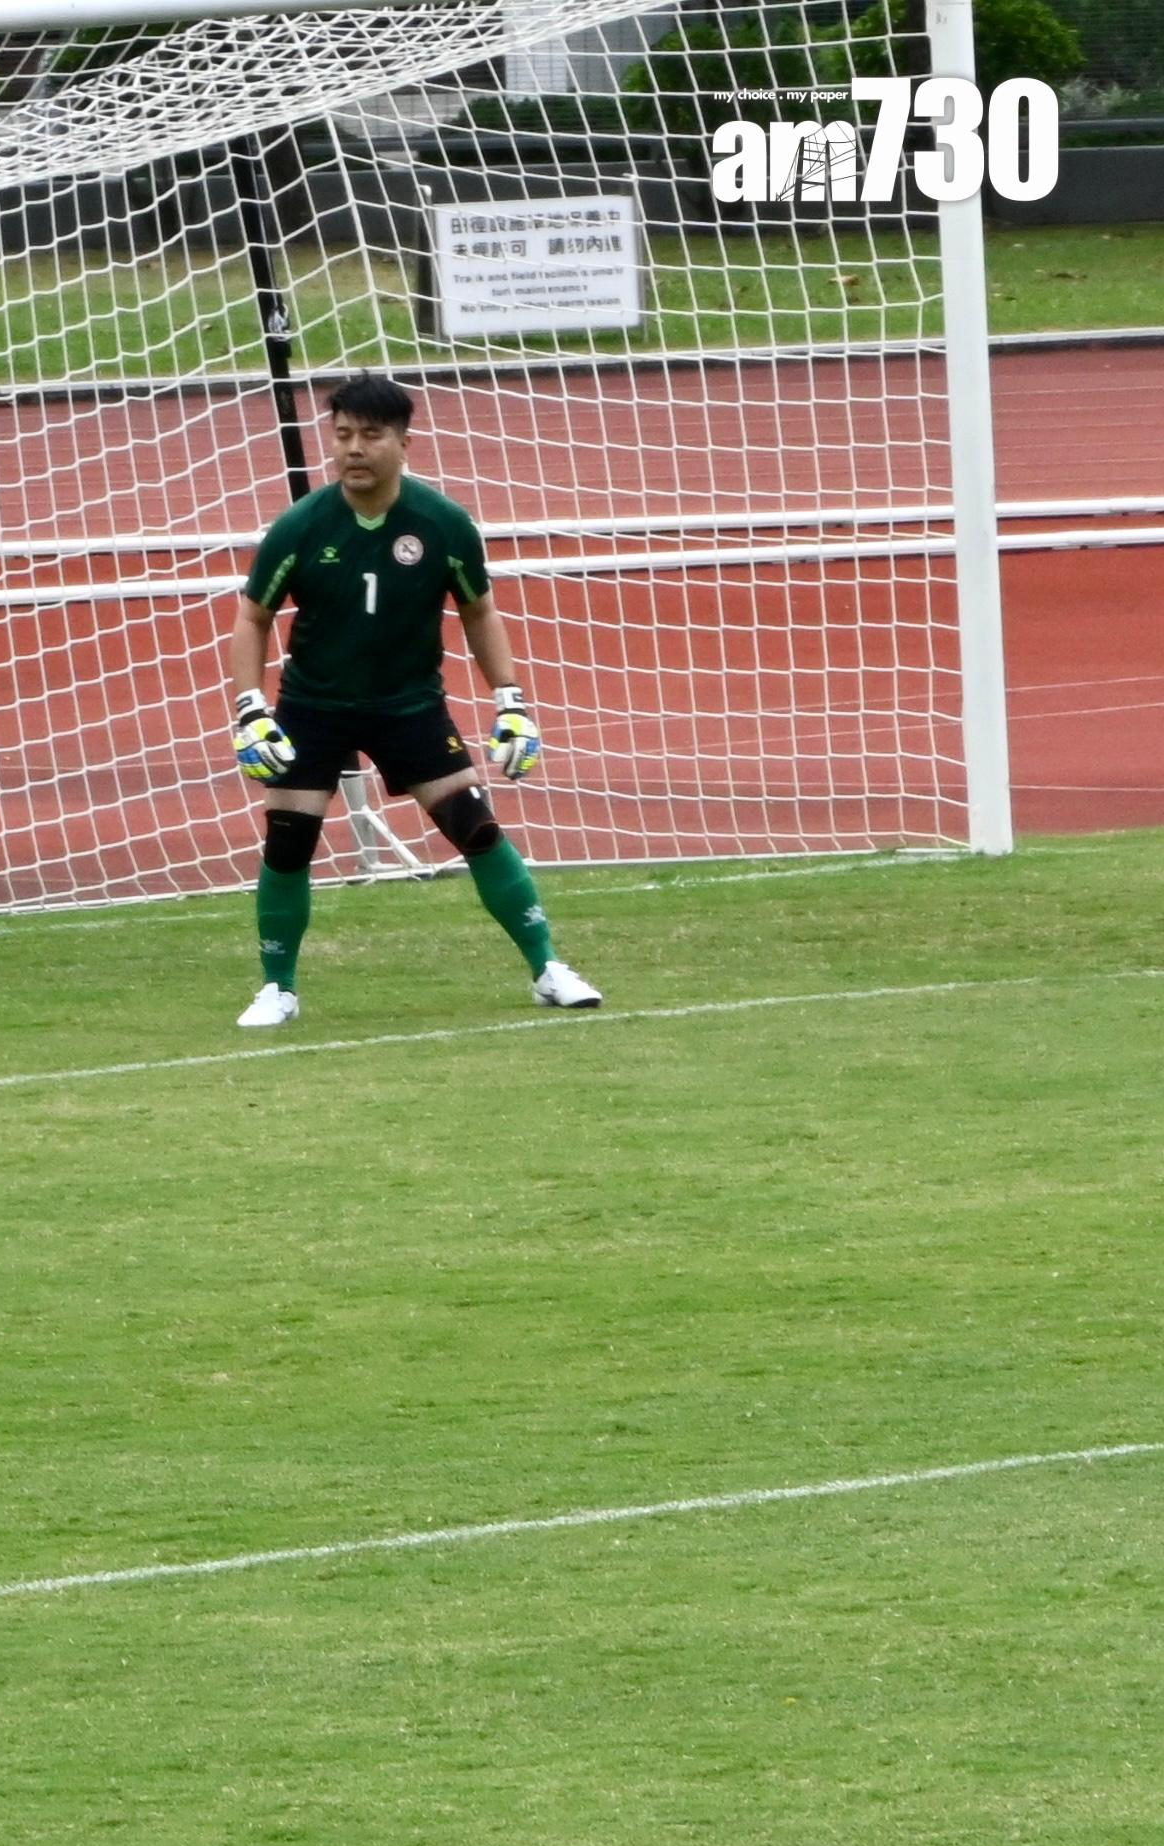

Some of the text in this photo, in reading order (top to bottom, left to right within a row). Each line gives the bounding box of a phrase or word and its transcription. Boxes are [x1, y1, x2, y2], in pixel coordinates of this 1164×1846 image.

[453, 274, 484, 284] Trak
[461, 304, 476, 313] No
[362, 572, 378, 614] 1
